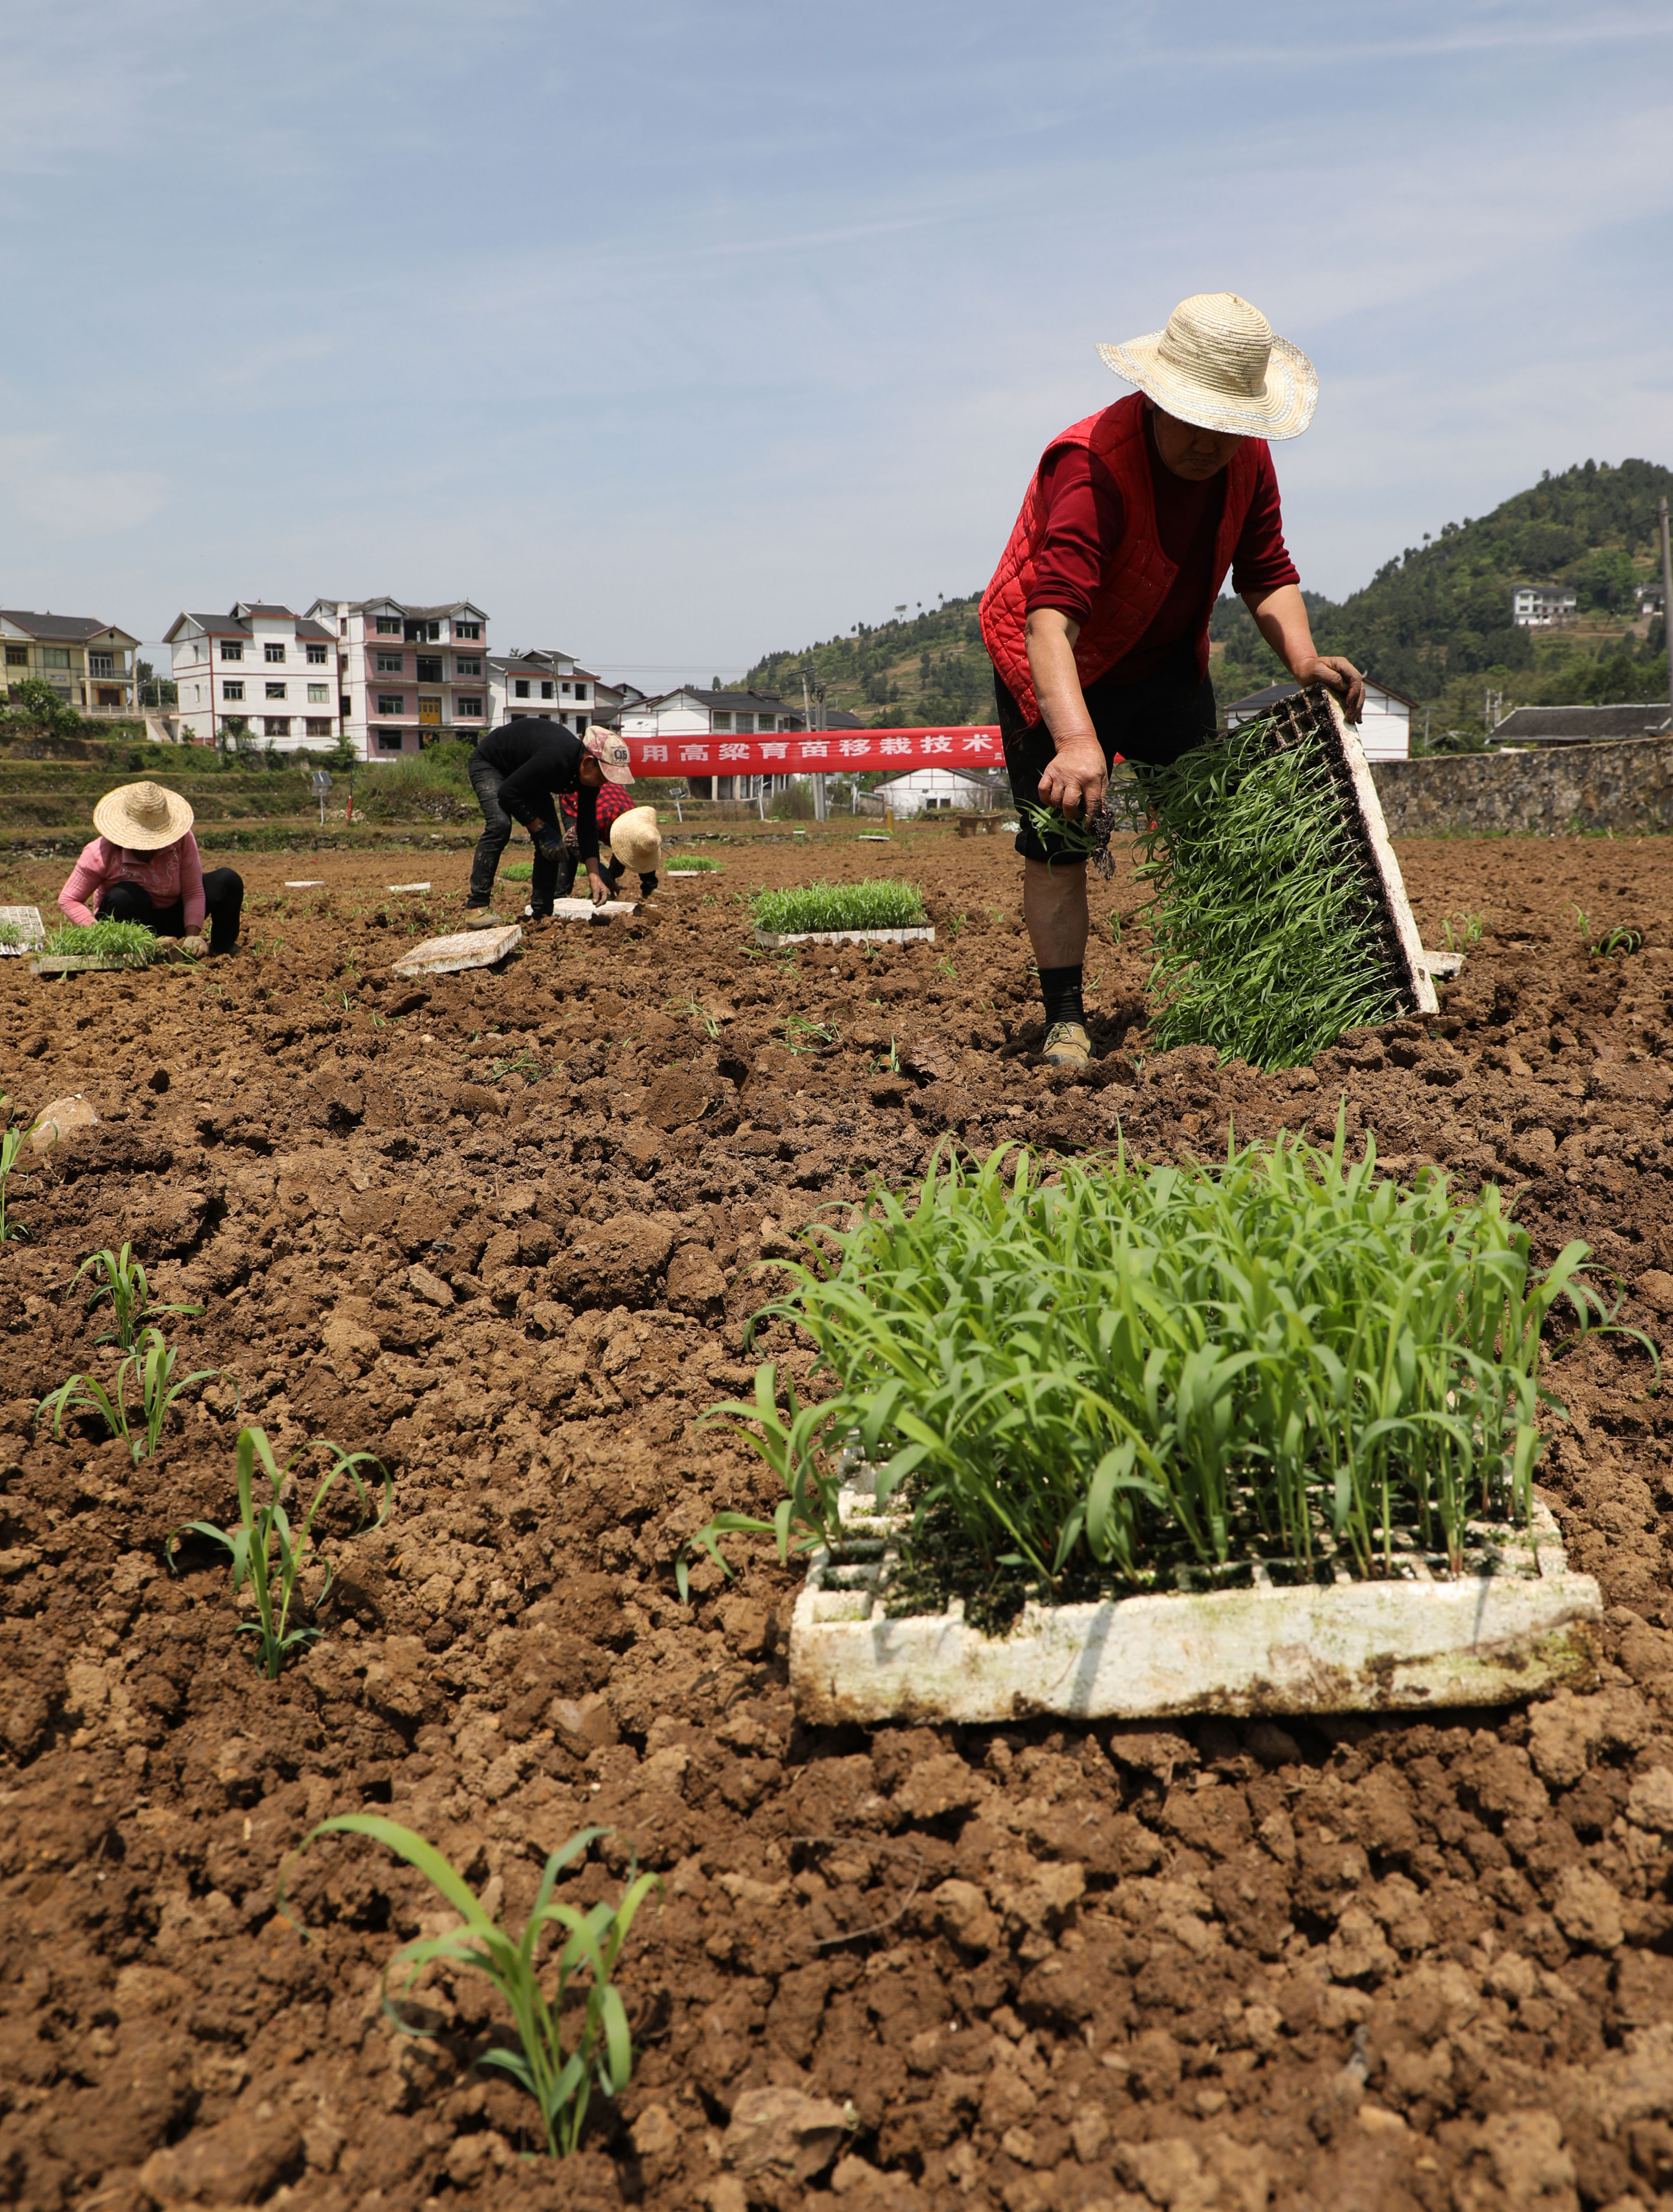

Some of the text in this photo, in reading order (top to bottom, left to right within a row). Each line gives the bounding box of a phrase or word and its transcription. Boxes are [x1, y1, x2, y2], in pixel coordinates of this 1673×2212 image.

[629, 733, 1003, 763] 用高粱育苗移栽技术
